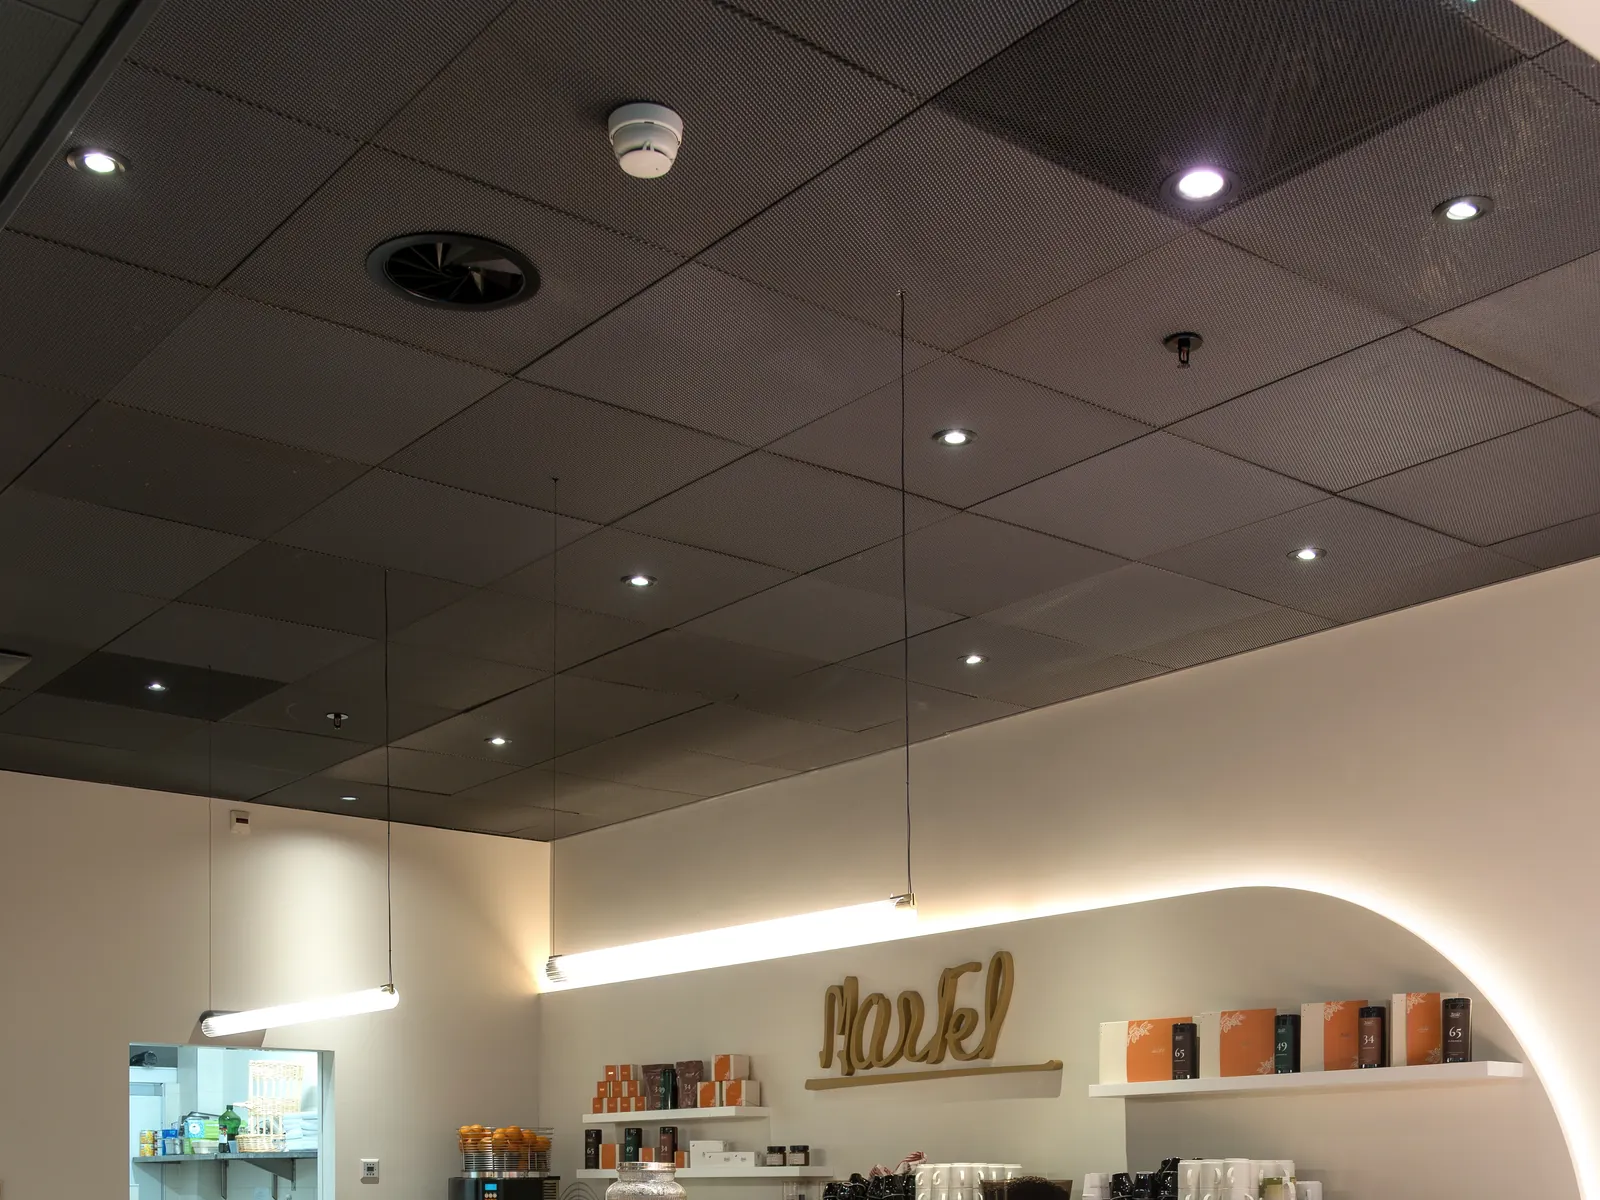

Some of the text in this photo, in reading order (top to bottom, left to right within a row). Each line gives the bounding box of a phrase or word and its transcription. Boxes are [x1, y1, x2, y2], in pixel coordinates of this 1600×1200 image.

[1449, 1026, 1462, 1039] 65
[1363, 1035, 1374, 1045] 34
[1277, 1041, 1288, 1052] 49
[1174, 1048, 1185, 1059] 65
